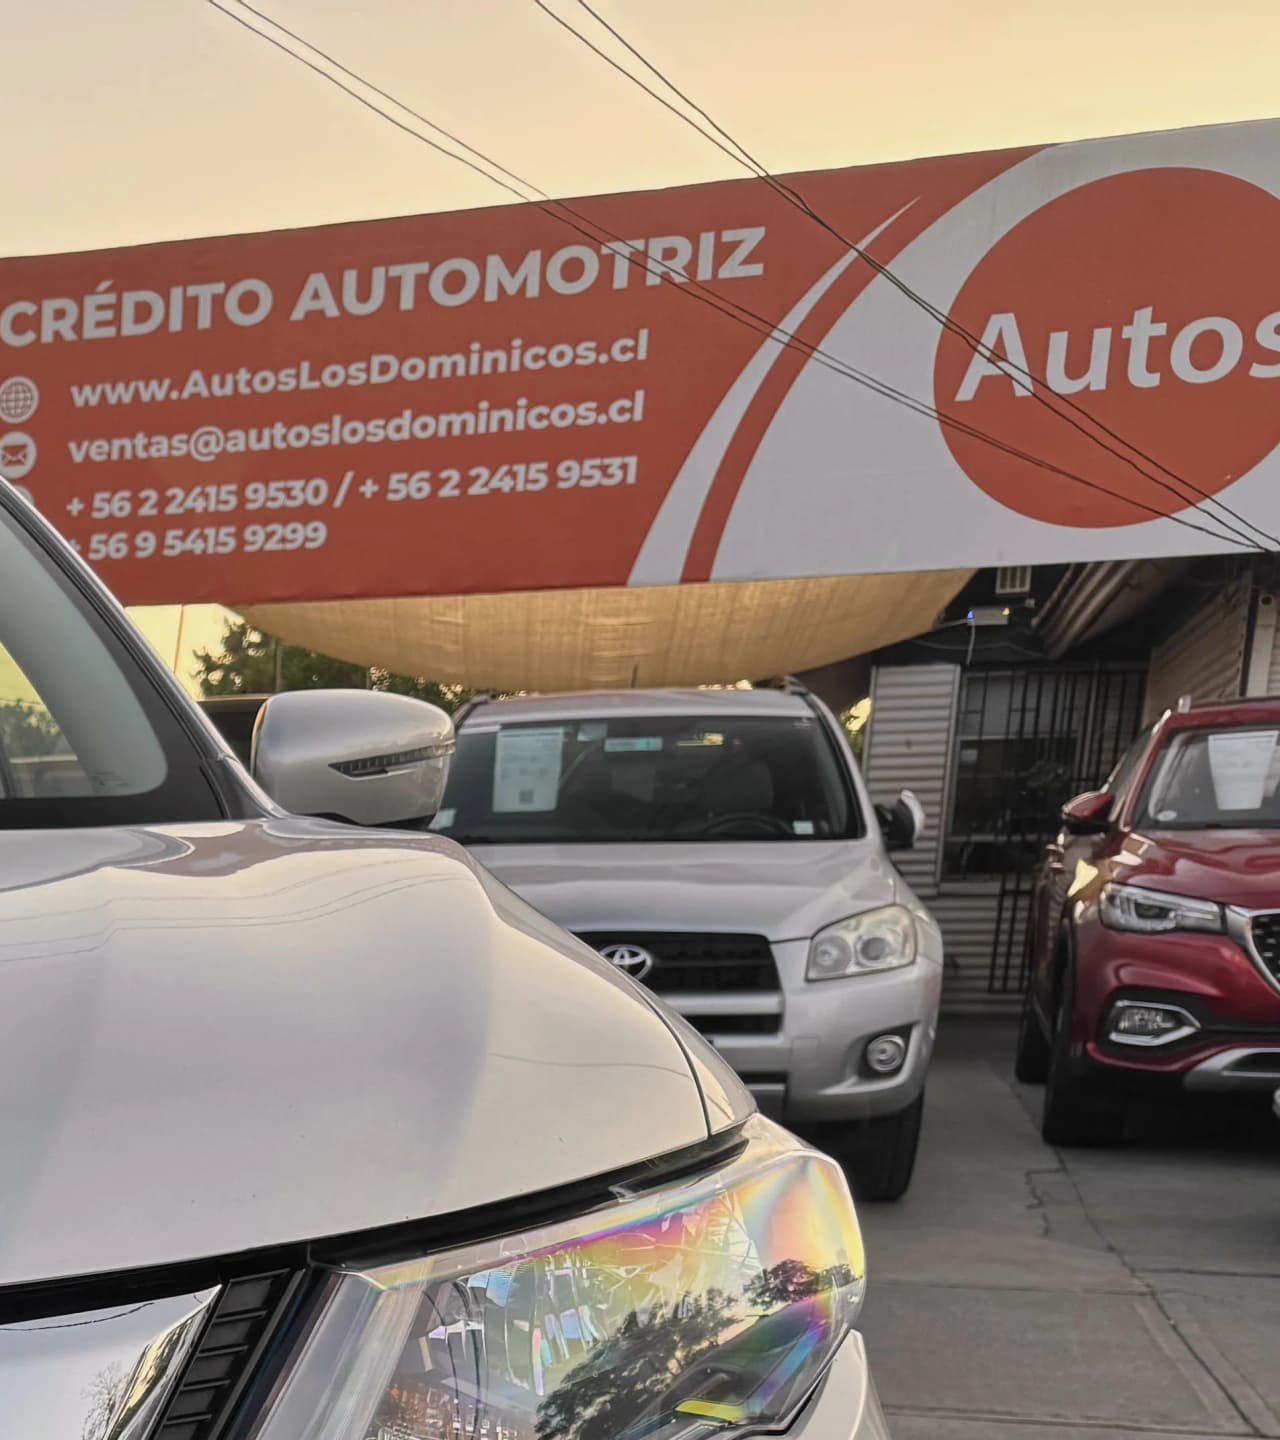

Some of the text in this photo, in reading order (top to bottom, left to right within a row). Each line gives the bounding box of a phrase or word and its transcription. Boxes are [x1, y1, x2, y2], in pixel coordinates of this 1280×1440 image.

[290, 226, 766, 321] AUTOMOTRIZ
[71, 330, 649, 406] www.AutosLosDominicos.cl
[69, 390, 645, 463] ventas@autoslosdominicos.cl
[66, 498, 84, 516] +
[92, 491, 132, 519] 56
[138, 489, 160, 516] 2
[165, 483, 238, 515] 2415
[245, 477, 329, 510] 9530
[359, 479, 380, 497] +
[387, 471, 433, 501] 56
[438, 468, 461, 498] 2
[467, 461, 549, 496] 2415
[556, 455, 638, 489] 9531
[88, 532, 129, 560] 56
[134, 530, 158, 558] 9
[163, 525, 237, 556] 5415
[244, 521, 327, 552] 9299
